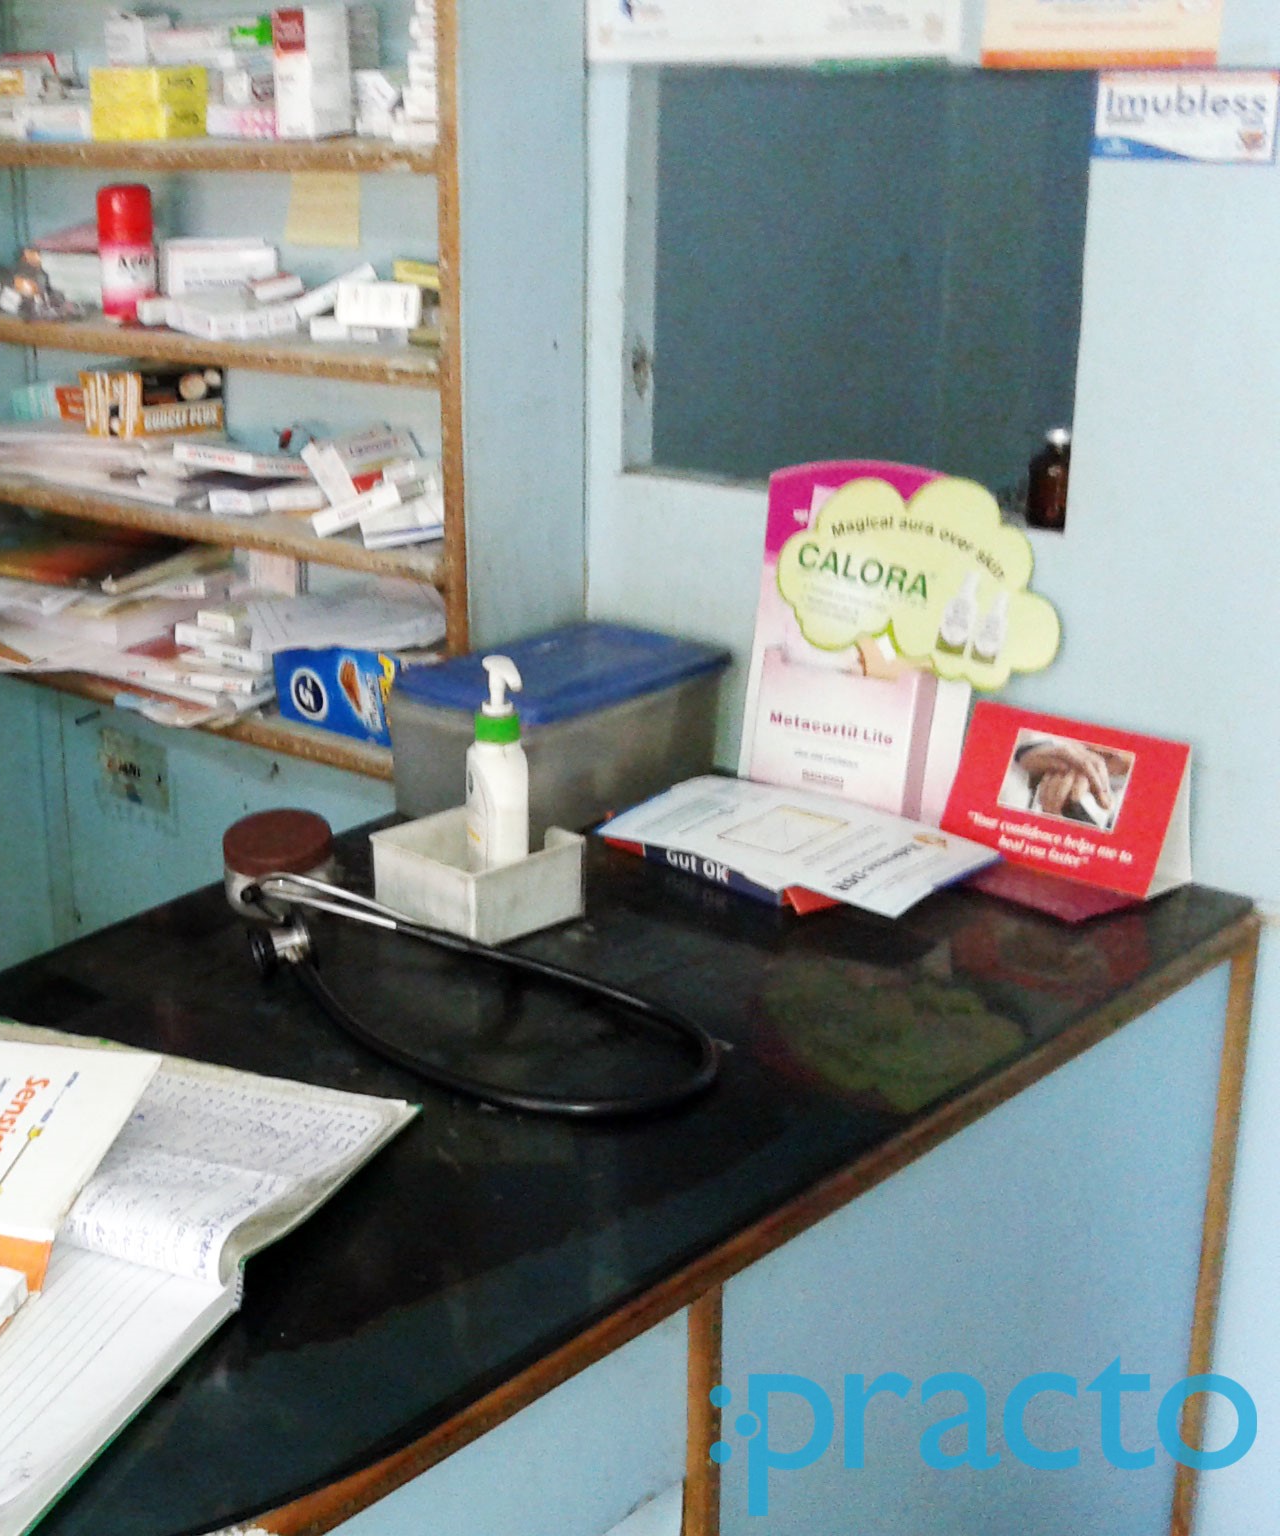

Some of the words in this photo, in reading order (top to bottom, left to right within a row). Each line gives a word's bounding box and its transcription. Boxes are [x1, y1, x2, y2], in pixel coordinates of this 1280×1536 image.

[1106, 84, 1267, 116] Imubless
[798, 542, 928, 599] CALORA
[831, 516, 894, 538] Magical
[899, 516, 934, 535] aura
[939, 528, 975, 551] over
[976, 549, 1005, 580] skin
[998, 834, 1024, 852] heal
[1023, 843, 1047, 860] you
[1000, 819, 1062, 845] confidence
[1064, 834, 1097, 857] helps
[1097, 845, 1118, 861] me
[1120, 850, 1134, 864] to
